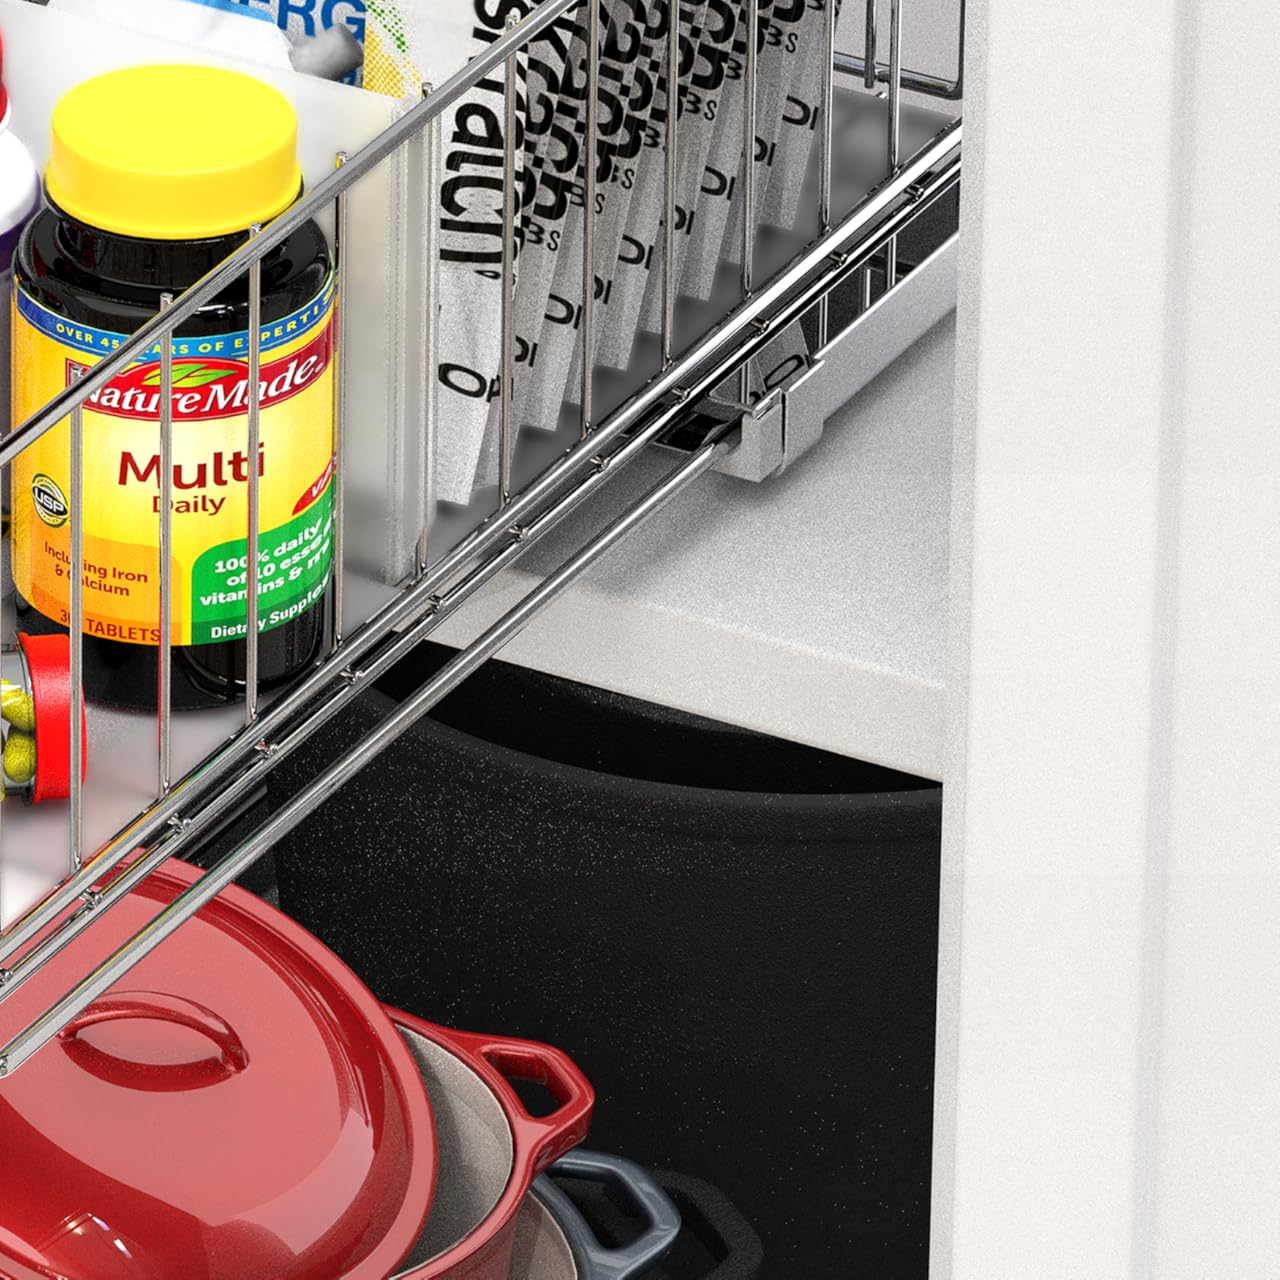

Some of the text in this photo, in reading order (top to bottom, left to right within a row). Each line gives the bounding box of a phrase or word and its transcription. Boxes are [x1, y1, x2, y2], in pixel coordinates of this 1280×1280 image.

[55, 322, 94, 344] OVER
[198, 341, 225, 354] OF
[35, 487, 65, 512] USP
[273, 517, 322, 558] daily
[45, 541, 148, 583] Incluing Iron
[55, 564, 64, 576] &
[288, 566, 303, 581] &
[86, 618, 161, 642] TABLETS
[211, 618, 266, 639] Dietay
